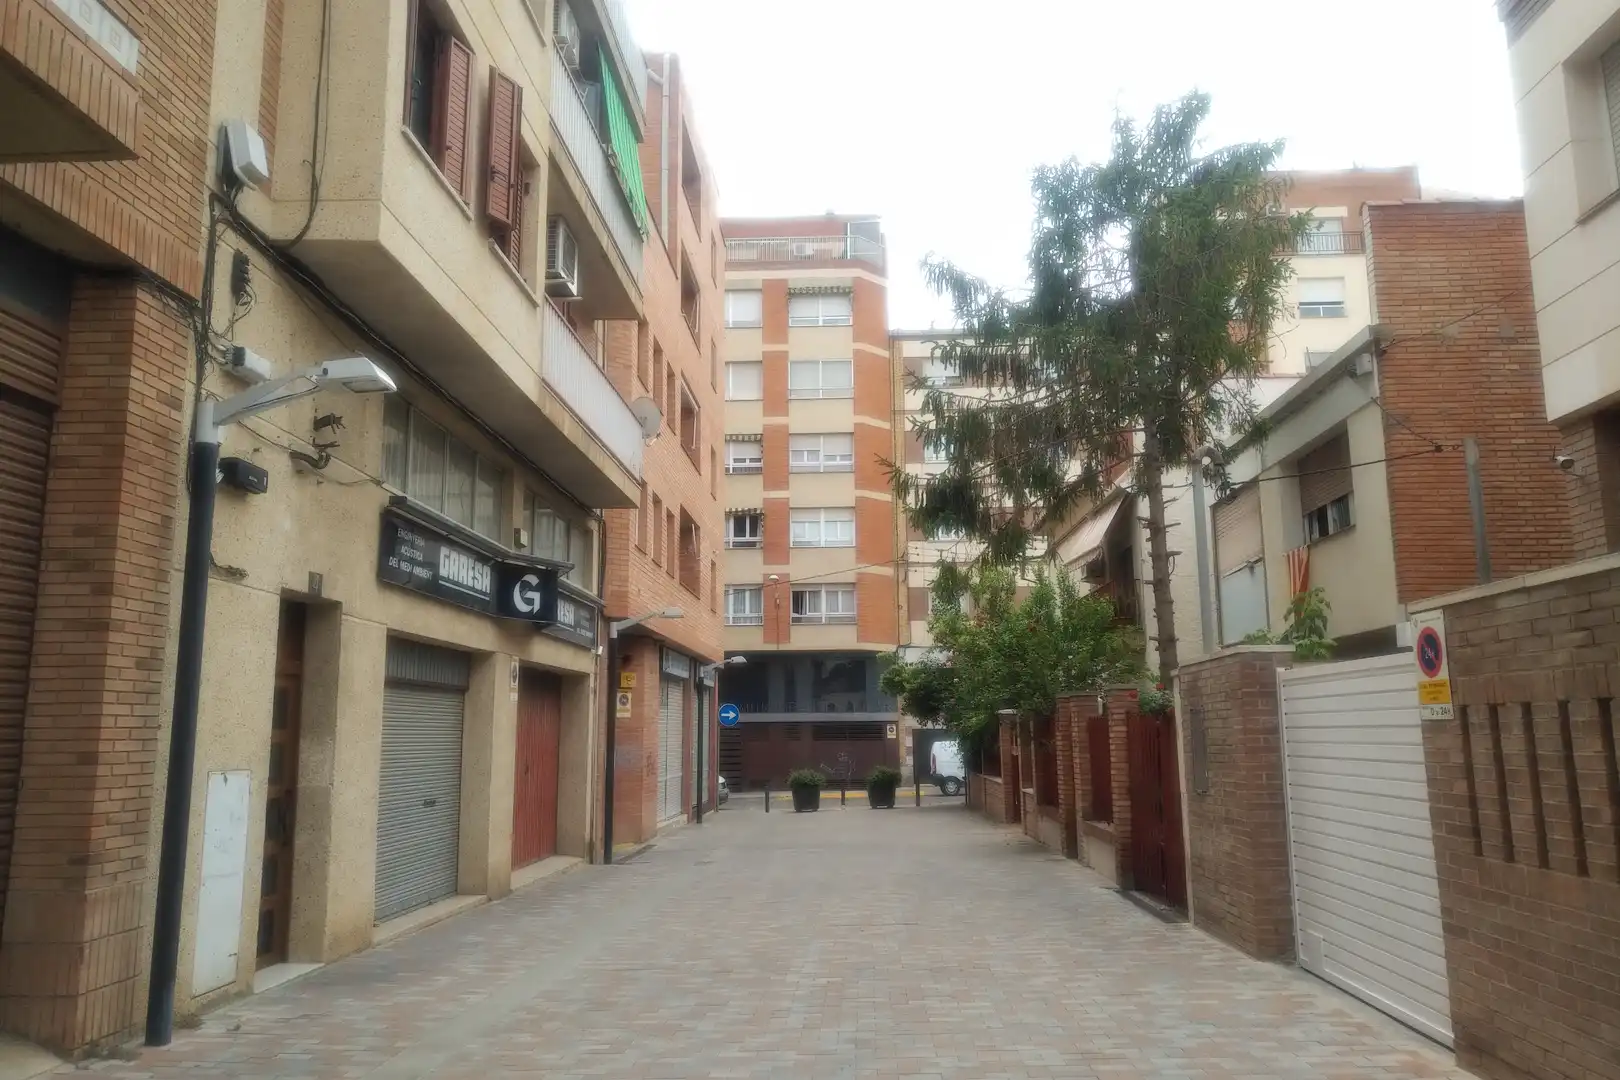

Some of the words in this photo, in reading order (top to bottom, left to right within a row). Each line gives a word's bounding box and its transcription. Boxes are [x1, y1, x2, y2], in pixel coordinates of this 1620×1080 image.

[389, 557, 399, 568] DEL
[400, 561, 413, 573] MEDI
[413, 565, 433, 580] AMBIENT
[513, 574, 541, 615] G
